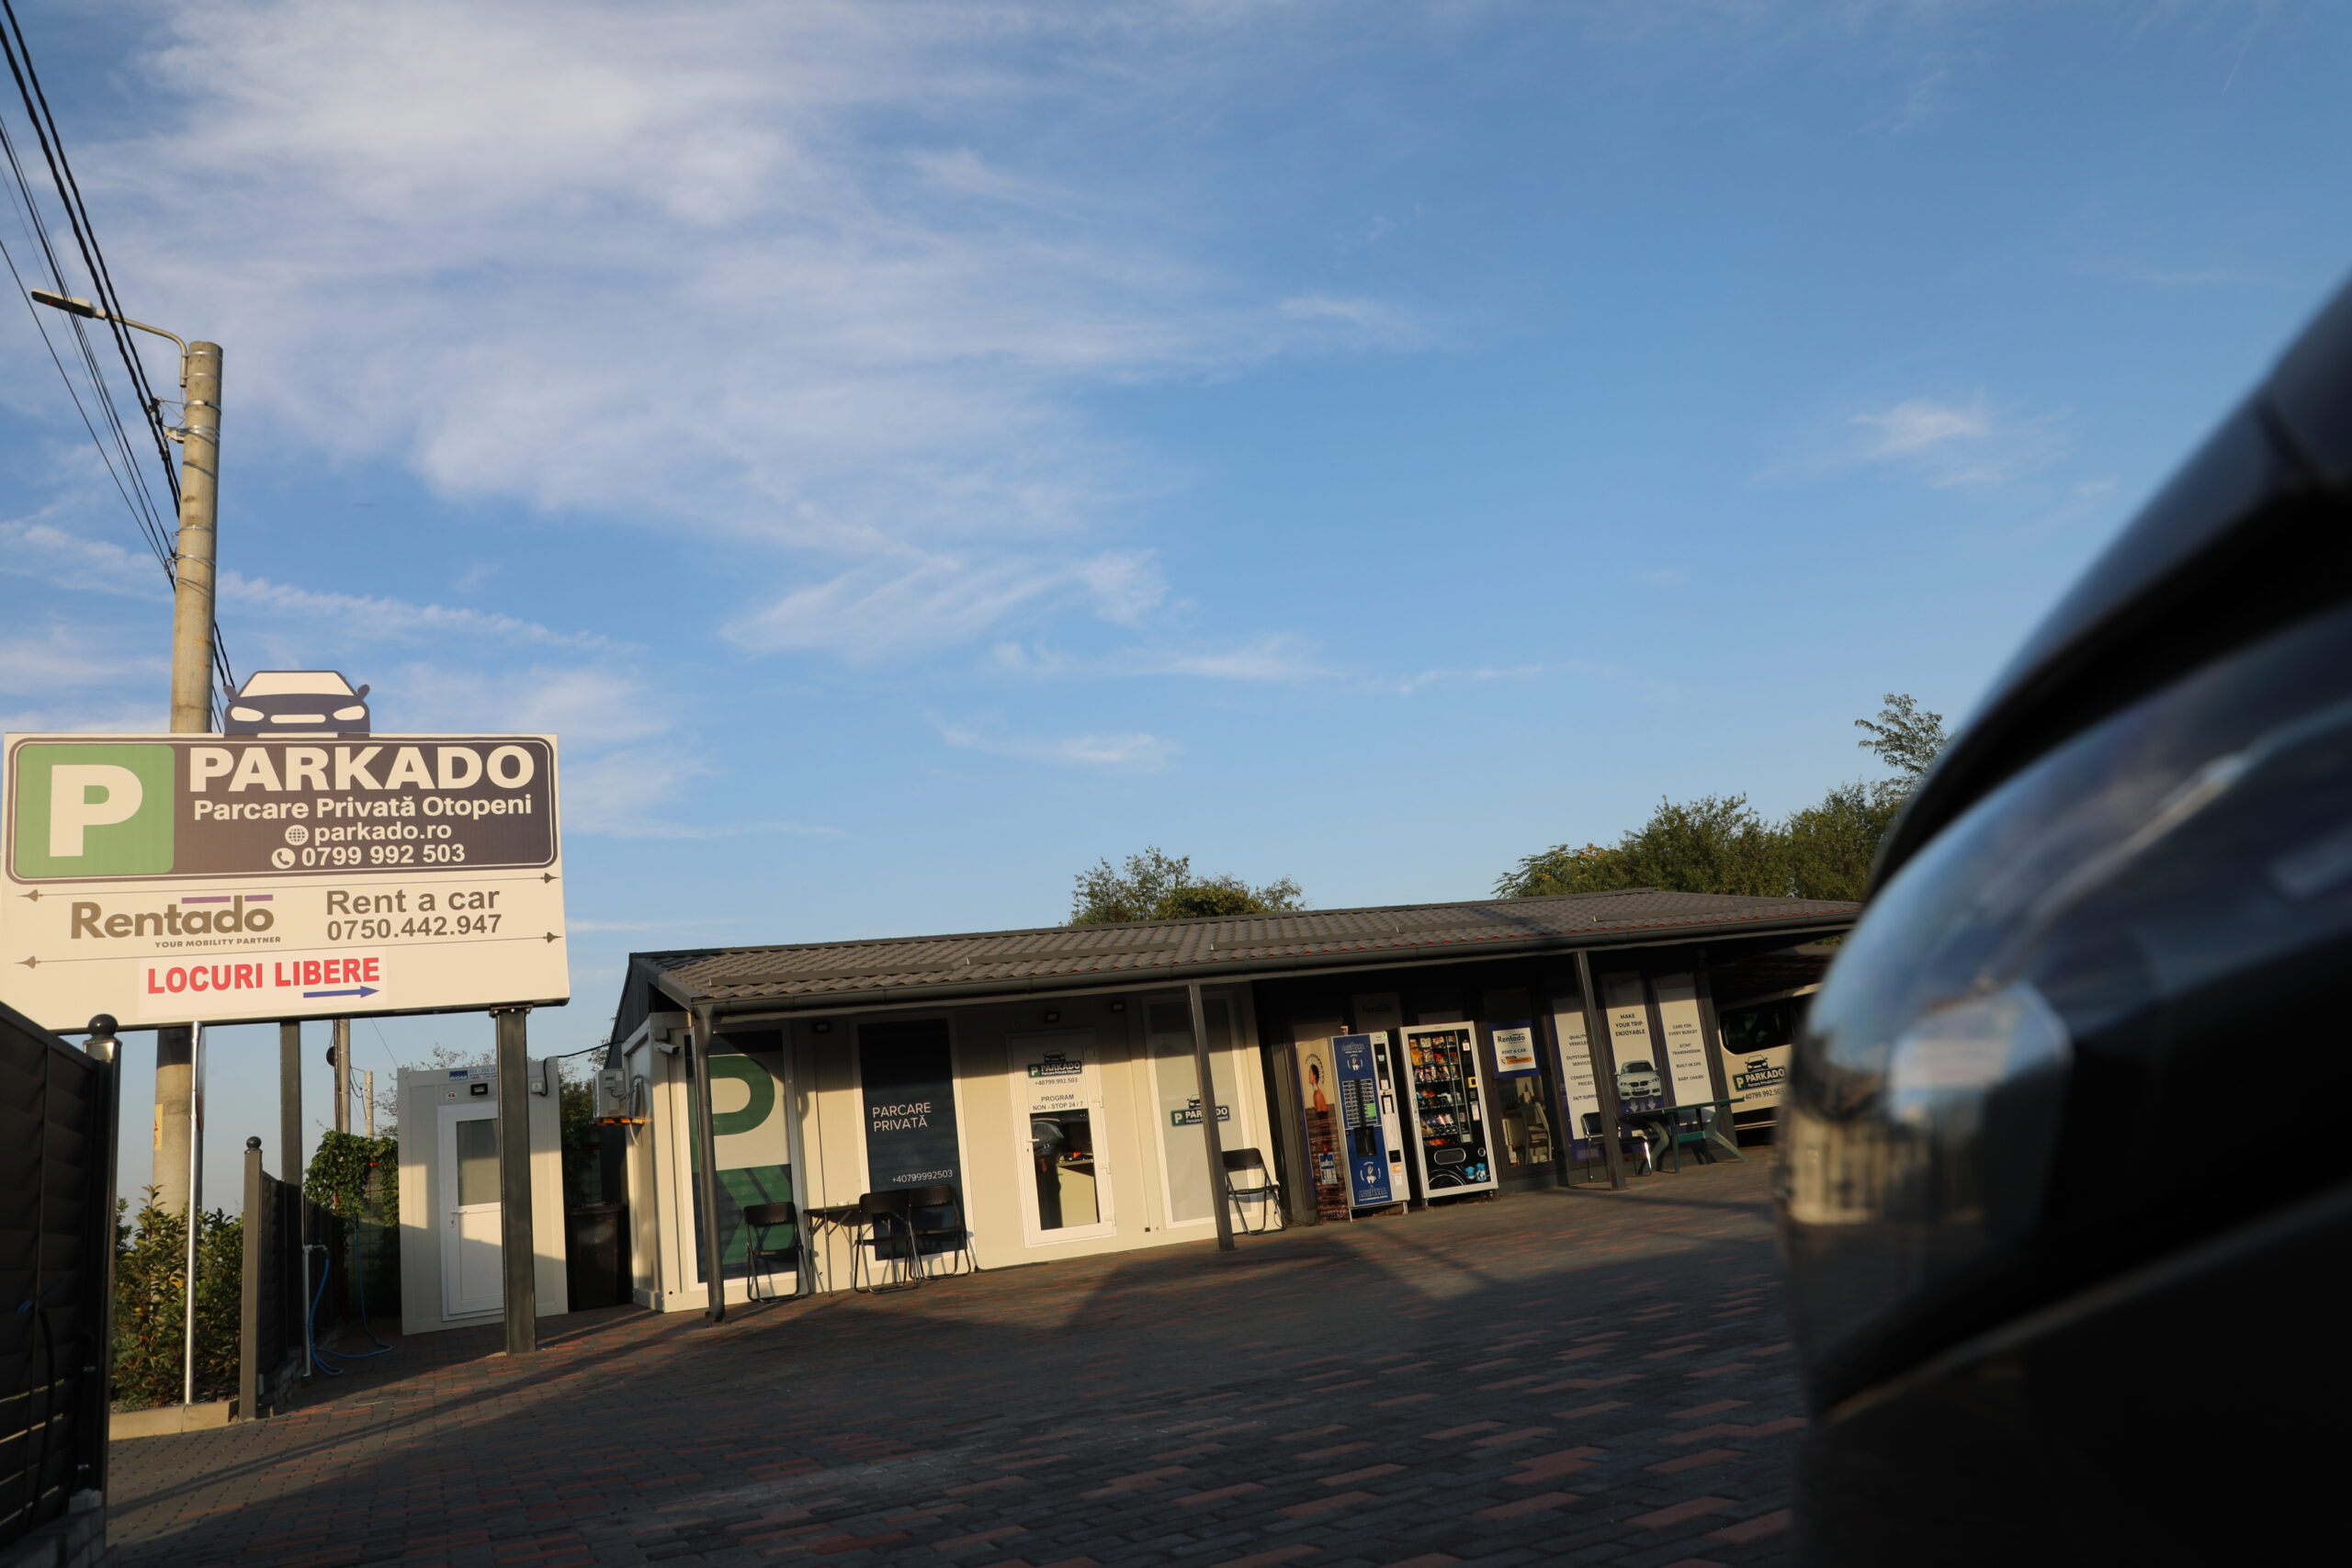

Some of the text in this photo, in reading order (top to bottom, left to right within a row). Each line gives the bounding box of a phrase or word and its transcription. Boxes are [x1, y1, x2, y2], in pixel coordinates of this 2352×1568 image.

[189, 745, 535, 793] PARKADO
[49, 763, 143, 858] P
[194, 794, 532, 821] Parcare Privată Otopeni
[314, 822, 452, 846] parkado.ro
[301, 843, 465, 867] 0799 992 503
[326, 889, 500, 915] Rent a car
[71, 895, 275, 940] Rentado
[327, 914, 502, 941] 0750.442.947
[186, 939, 233, 947] MOBILITY
[236, 936, 281, 945] PARTNER
[148, 957, 379, 994] LOCURI LIBERE
[1498, 1034, 1525, 1043] Rentado
[1031, 1066, 1038, 1076] P
[1041, 1062, 1080, 1072] PARKADO
[1745, 1068, 1785, 1082] PARKADO
[1035, 1077, 1078, 1086] +40799.992.503
[1736, 1077, 1744, 1089] P
[1041, 1094, 1074, 1102] PROGRAM
[872, 1101, 932, 1118] PARCARE
[1174, 1112, 1182, 1123] P
[1185, 1107, 1228, 1119] PARDO
[874, 1115, 927, 1132] PRIVATĂ
[892, 1168, 953, 1183] +40799992503
